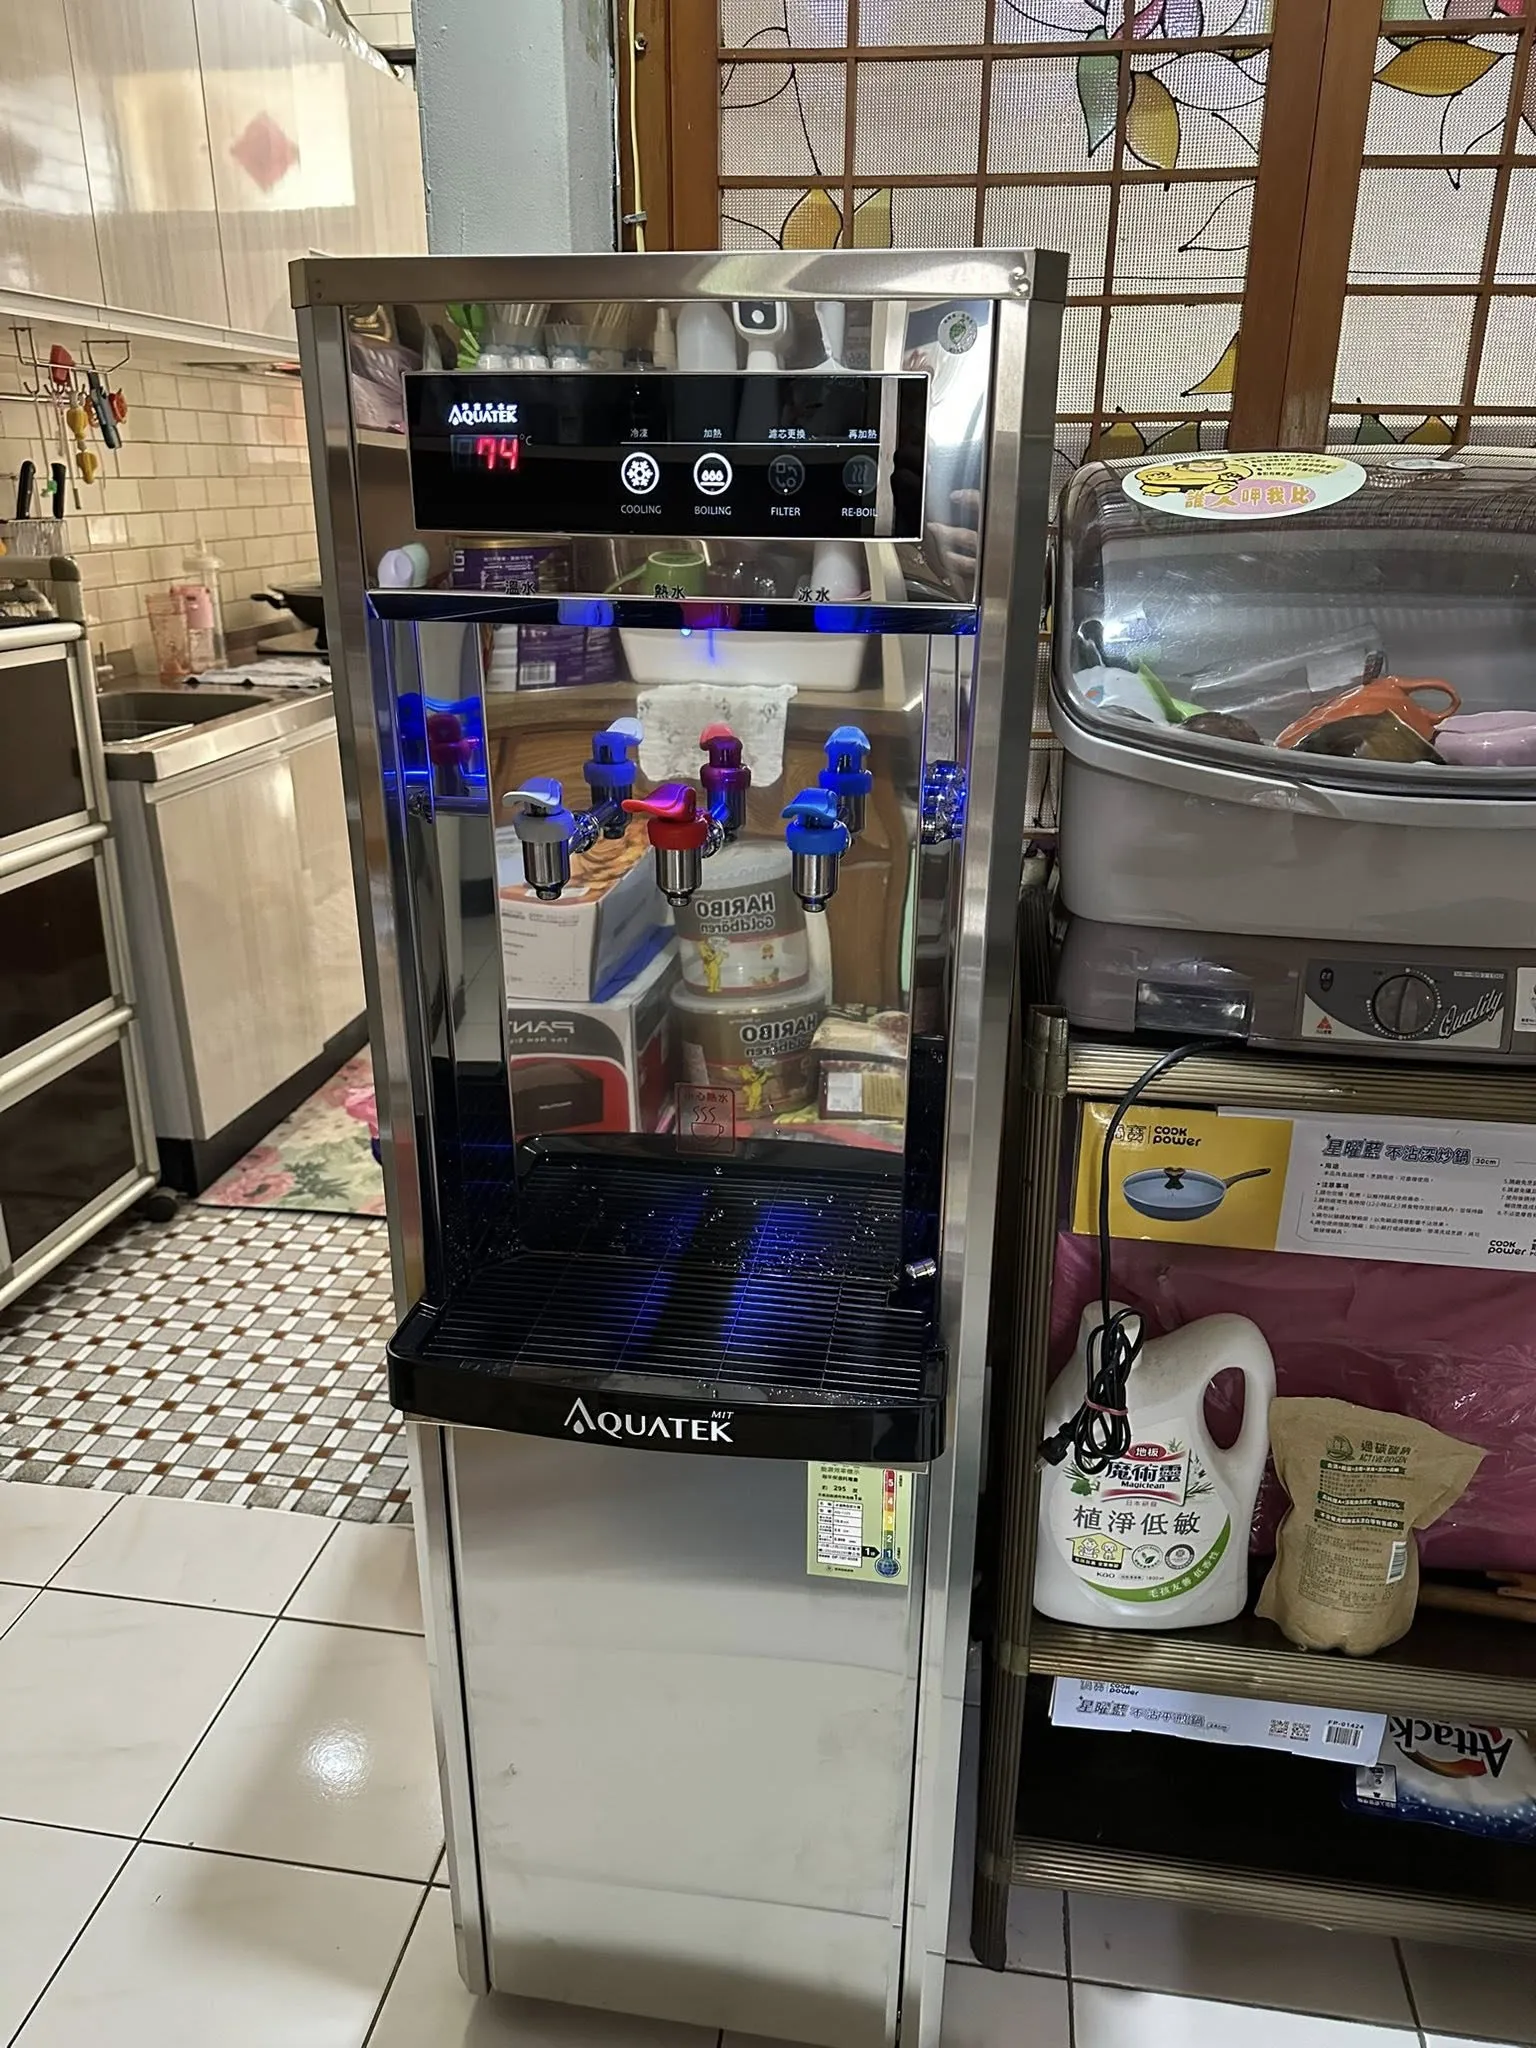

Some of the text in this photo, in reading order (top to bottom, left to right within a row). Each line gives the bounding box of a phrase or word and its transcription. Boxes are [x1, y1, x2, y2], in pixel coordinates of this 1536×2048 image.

[448, 404, 518, 426] AQUATEK
[703, 428, 722, 438] 加熱
[768, 428, 806, 439] 濾芯更換
[848, 429, 877, 439] 再加熱
[477, 436, 518, 470] 74
[620, 504, 662, 514] COOLING
[694, 506, 732, 515] BOILING
[770, 507, 801, 516] FILTER
[654, 584, 685, 599] 熱水
[799, 587, 830, 602] 冰水
[1439, 988, 1504, 1038] Quality
[564, 1397, 735, 1443] AQUATEK MIT
[1135, 1447, 1159, 1457] 地板
[1105, 1461, 1182, 1483] 魔術靈
[1120, 1480, 1165, 1489] Magiclean
[1073, 1504, 1201, 1536] 植淨低敏
[886, 1535, 893, 1543] 2
[1389, 1716, 1514, 1778] Attack
